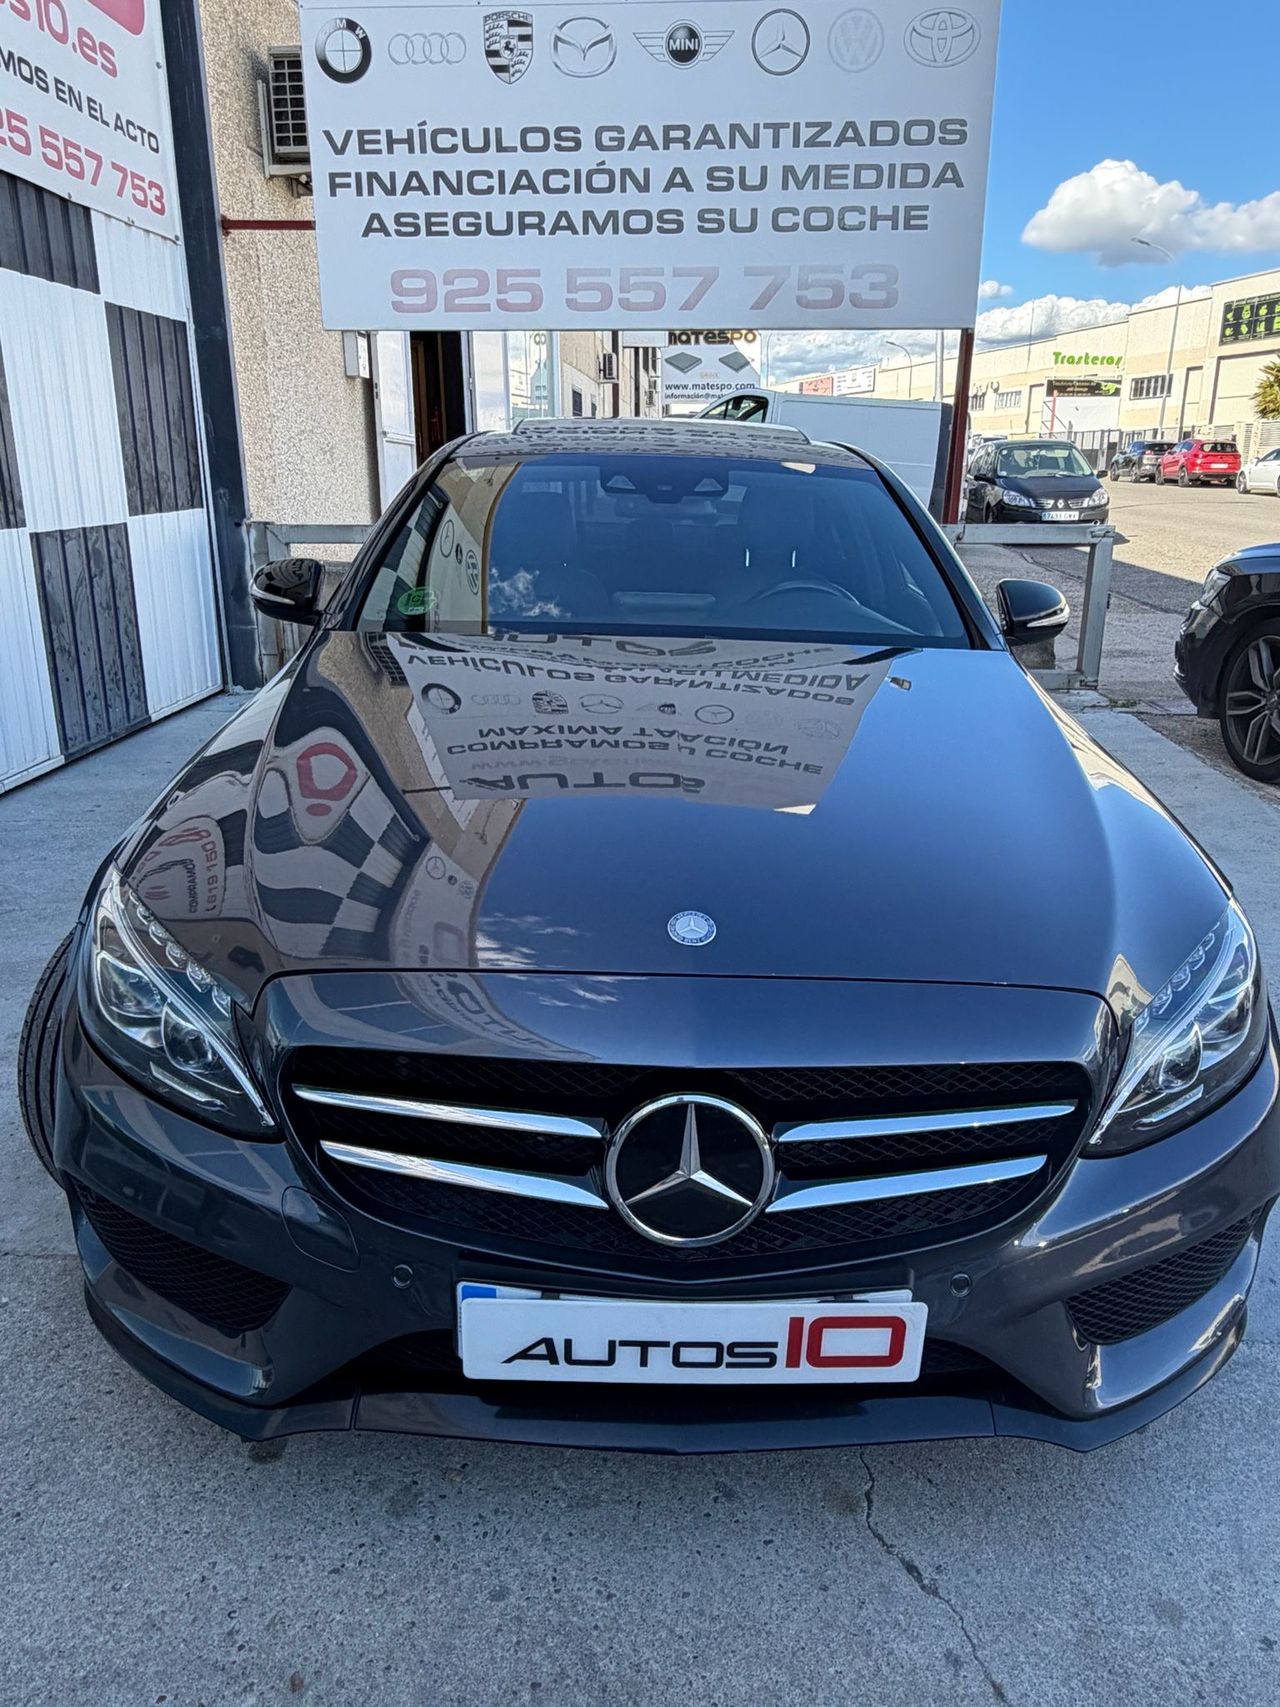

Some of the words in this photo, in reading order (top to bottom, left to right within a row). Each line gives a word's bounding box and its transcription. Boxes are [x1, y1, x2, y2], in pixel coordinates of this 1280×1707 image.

[0, 0, 118, 78] s10.es
[669, 38, 699, 51] MINI
[0, 47, 49, 94] MOS
[54, 76, 83, 113] EN
[87, 96, 110, 128] EL
[113, 112, 160, 154] ACTO
[322, 120, 582, 156] VEHÍCULOS
[594, 118, 968, 152] GARANTIZADOS
[39, 125, 103, 186] 557
[111, 161, 166, 216] 753
[328, 160, 650, 197] FINANCIACIÓN
[662, 166, 695, 193] A
[706, 165, 768, 193] SU
[781, 162, 965, 191] MEDIDA
[361, 209, 685, 238] ASEGURAMOS
[697, 207, 758, 234] SU
[771, 204, 929, 233] COCHE
[391, 268, 544, 313] 925
[565, 265, 720, 313] 557
[743, 263, 899, 312] 753
[1053, 351, 1123, 366] Trasteros
[665, 382, 755, 393] www.matespo.com
[501, 1315, 907, 1369] AUTOS10
